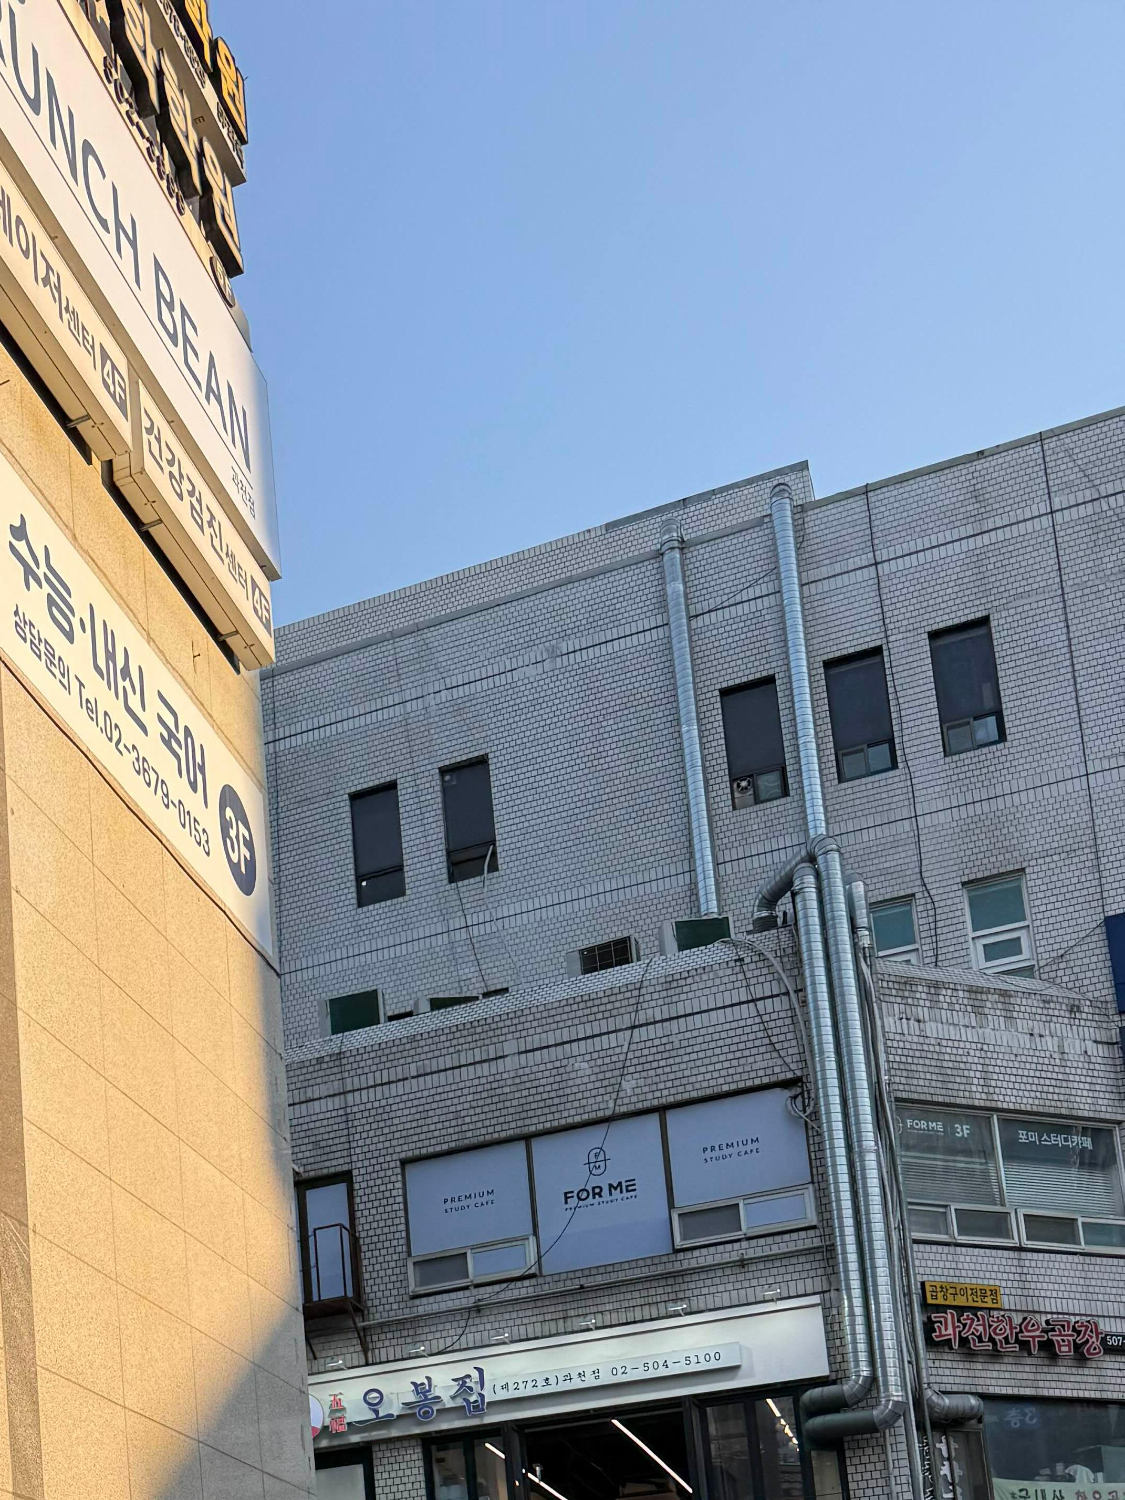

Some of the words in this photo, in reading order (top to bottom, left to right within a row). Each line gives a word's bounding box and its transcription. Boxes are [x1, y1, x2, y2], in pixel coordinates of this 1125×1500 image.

[153, 252, 251, 474] BEAN
[101, 357, 127, 418] 4F
[143, 406, 250, 602] 건강검진센터
[252, 583, 272, 632] 4F
[13, 602, 72, 697] 상담문의
[156, 688, 209, 810] 국어
[224, 804, 252, 876] 3F
[702, 1135, 761, 1154] PREMIUM
[954, 1123, 972, 1139] 3F
[1017, 1129, 1040, 1146] 포미
[442, 1187, 496, 1205] PREMIUM
[563, 1185, 604, 1205] FOR
[607, 1178, 637, 1197] ME
[928, 1284, 1000, 1306] 곱창구이전문점
[931, 1309, 1105, 1359] 과천한우곱창
[610, 1350, 723, 1377] 02-504-5100
[359, 1365, 487, 1422] 오봉집
